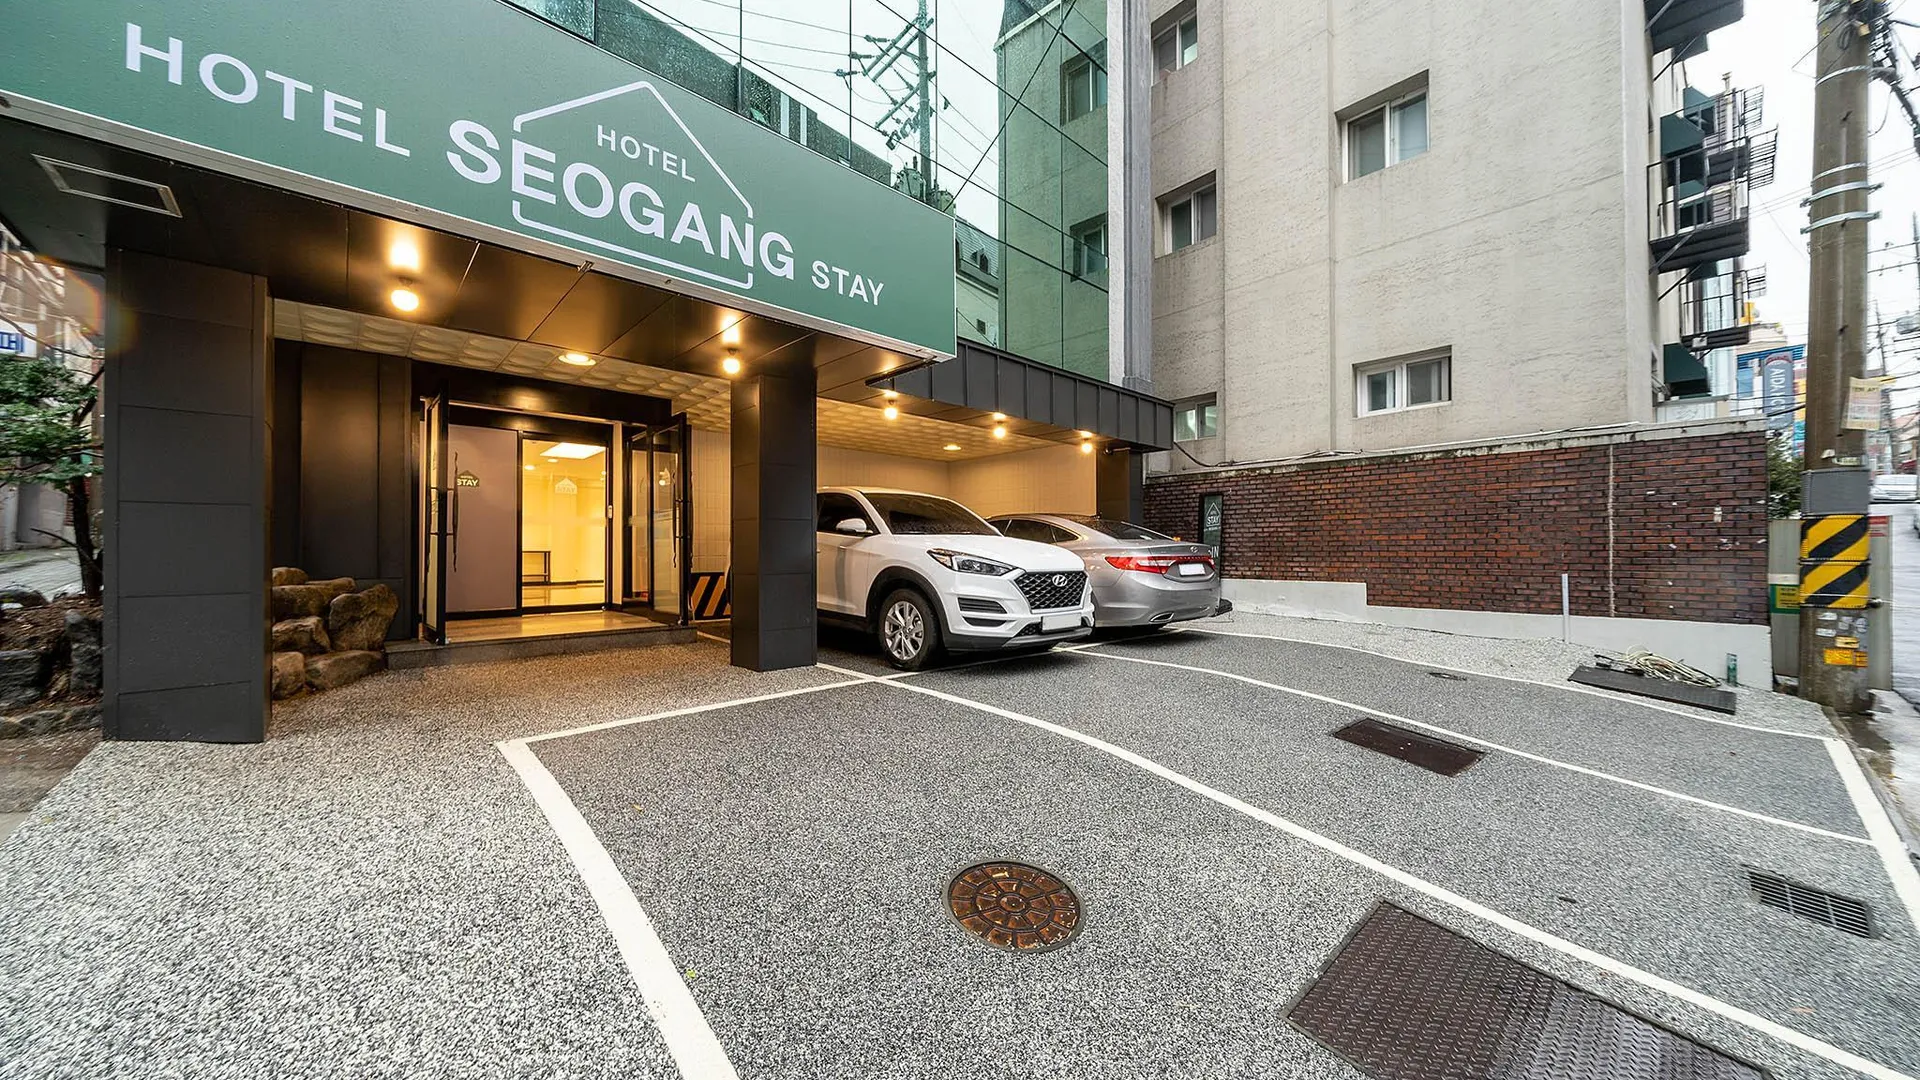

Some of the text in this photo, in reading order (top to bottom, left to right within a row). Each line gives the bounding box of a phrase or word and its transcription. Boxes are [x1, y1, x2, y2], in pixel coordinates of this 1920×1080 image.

[126, 22, 885, 306] HOTEL SEOGANG STAY
[597, 125, 696, 182] HOTEL
